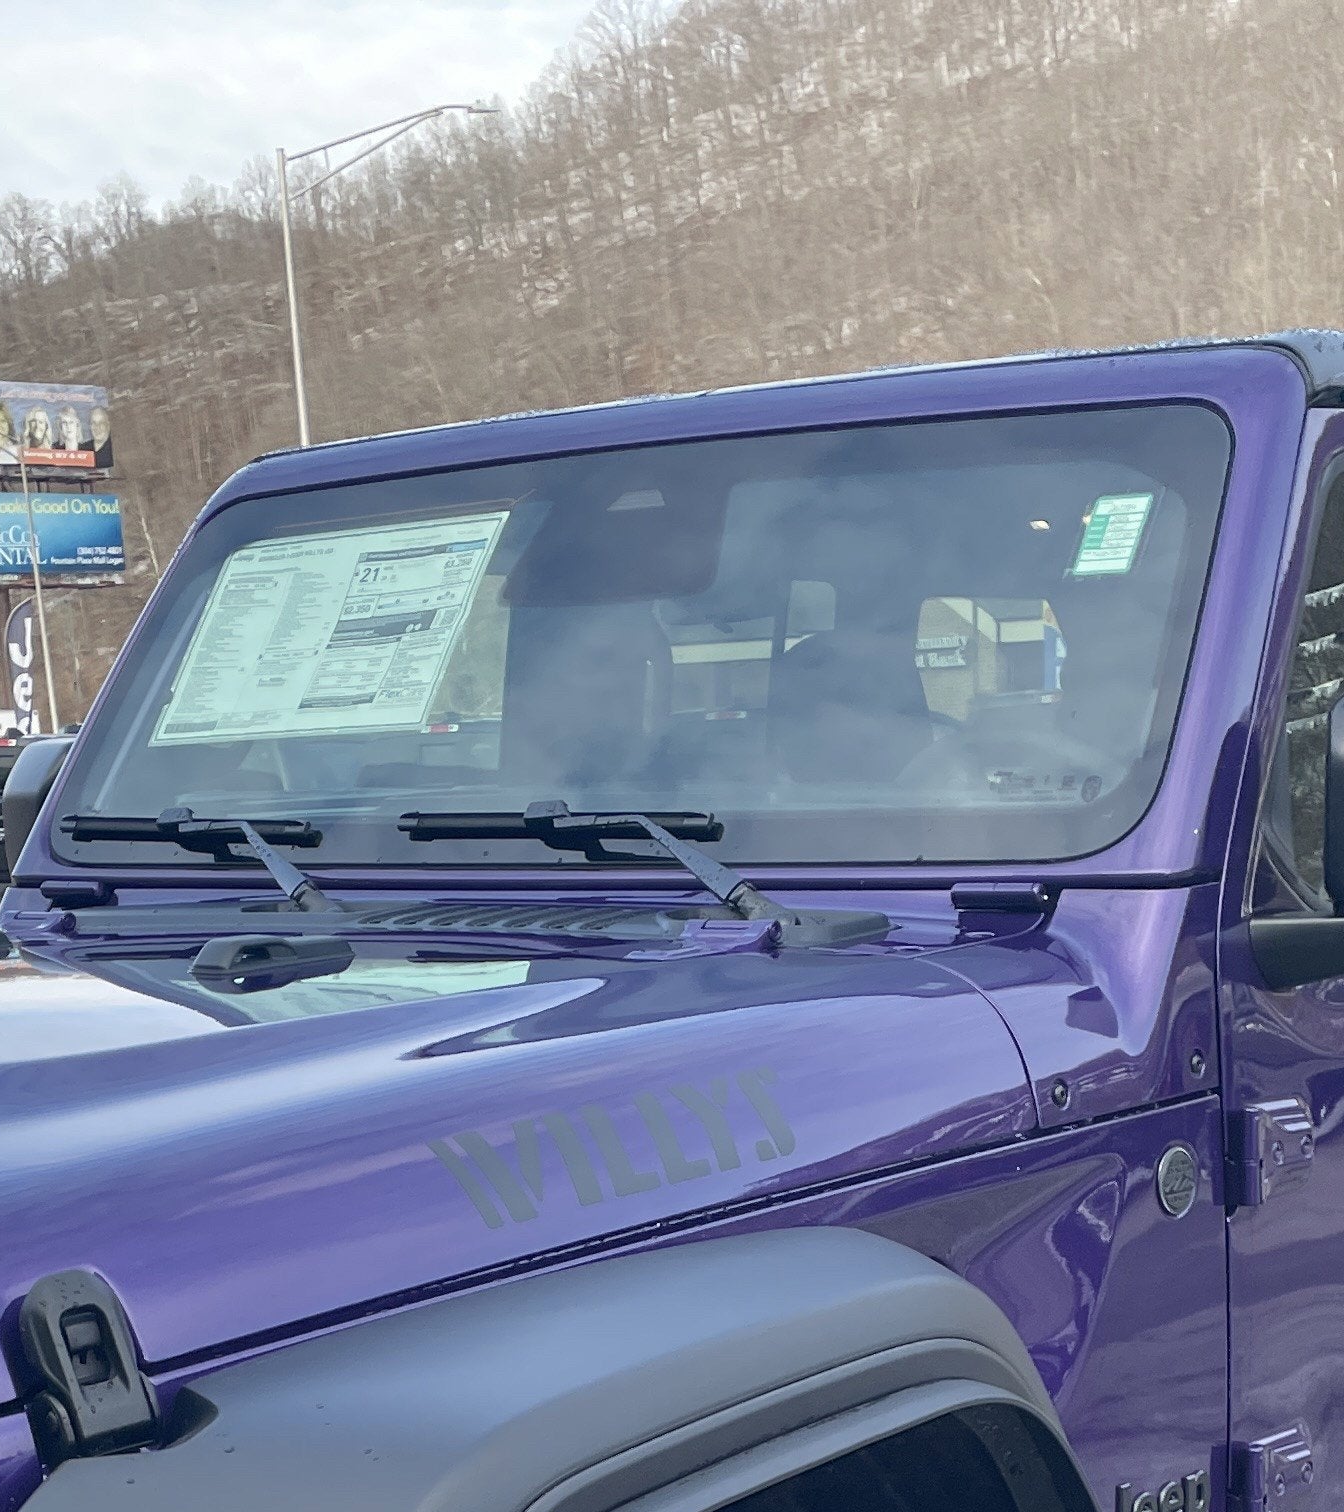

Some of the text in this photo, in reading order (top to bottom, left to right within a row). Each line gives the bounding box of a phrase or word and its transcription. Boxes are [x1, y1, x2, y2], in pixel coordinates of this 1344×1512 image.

[31, 498, 69, 515] Good
[71, 498, 92, 515] On
[359, 567, 381, 583] 21
[426, 1068, 796, 1229] WILLYS
